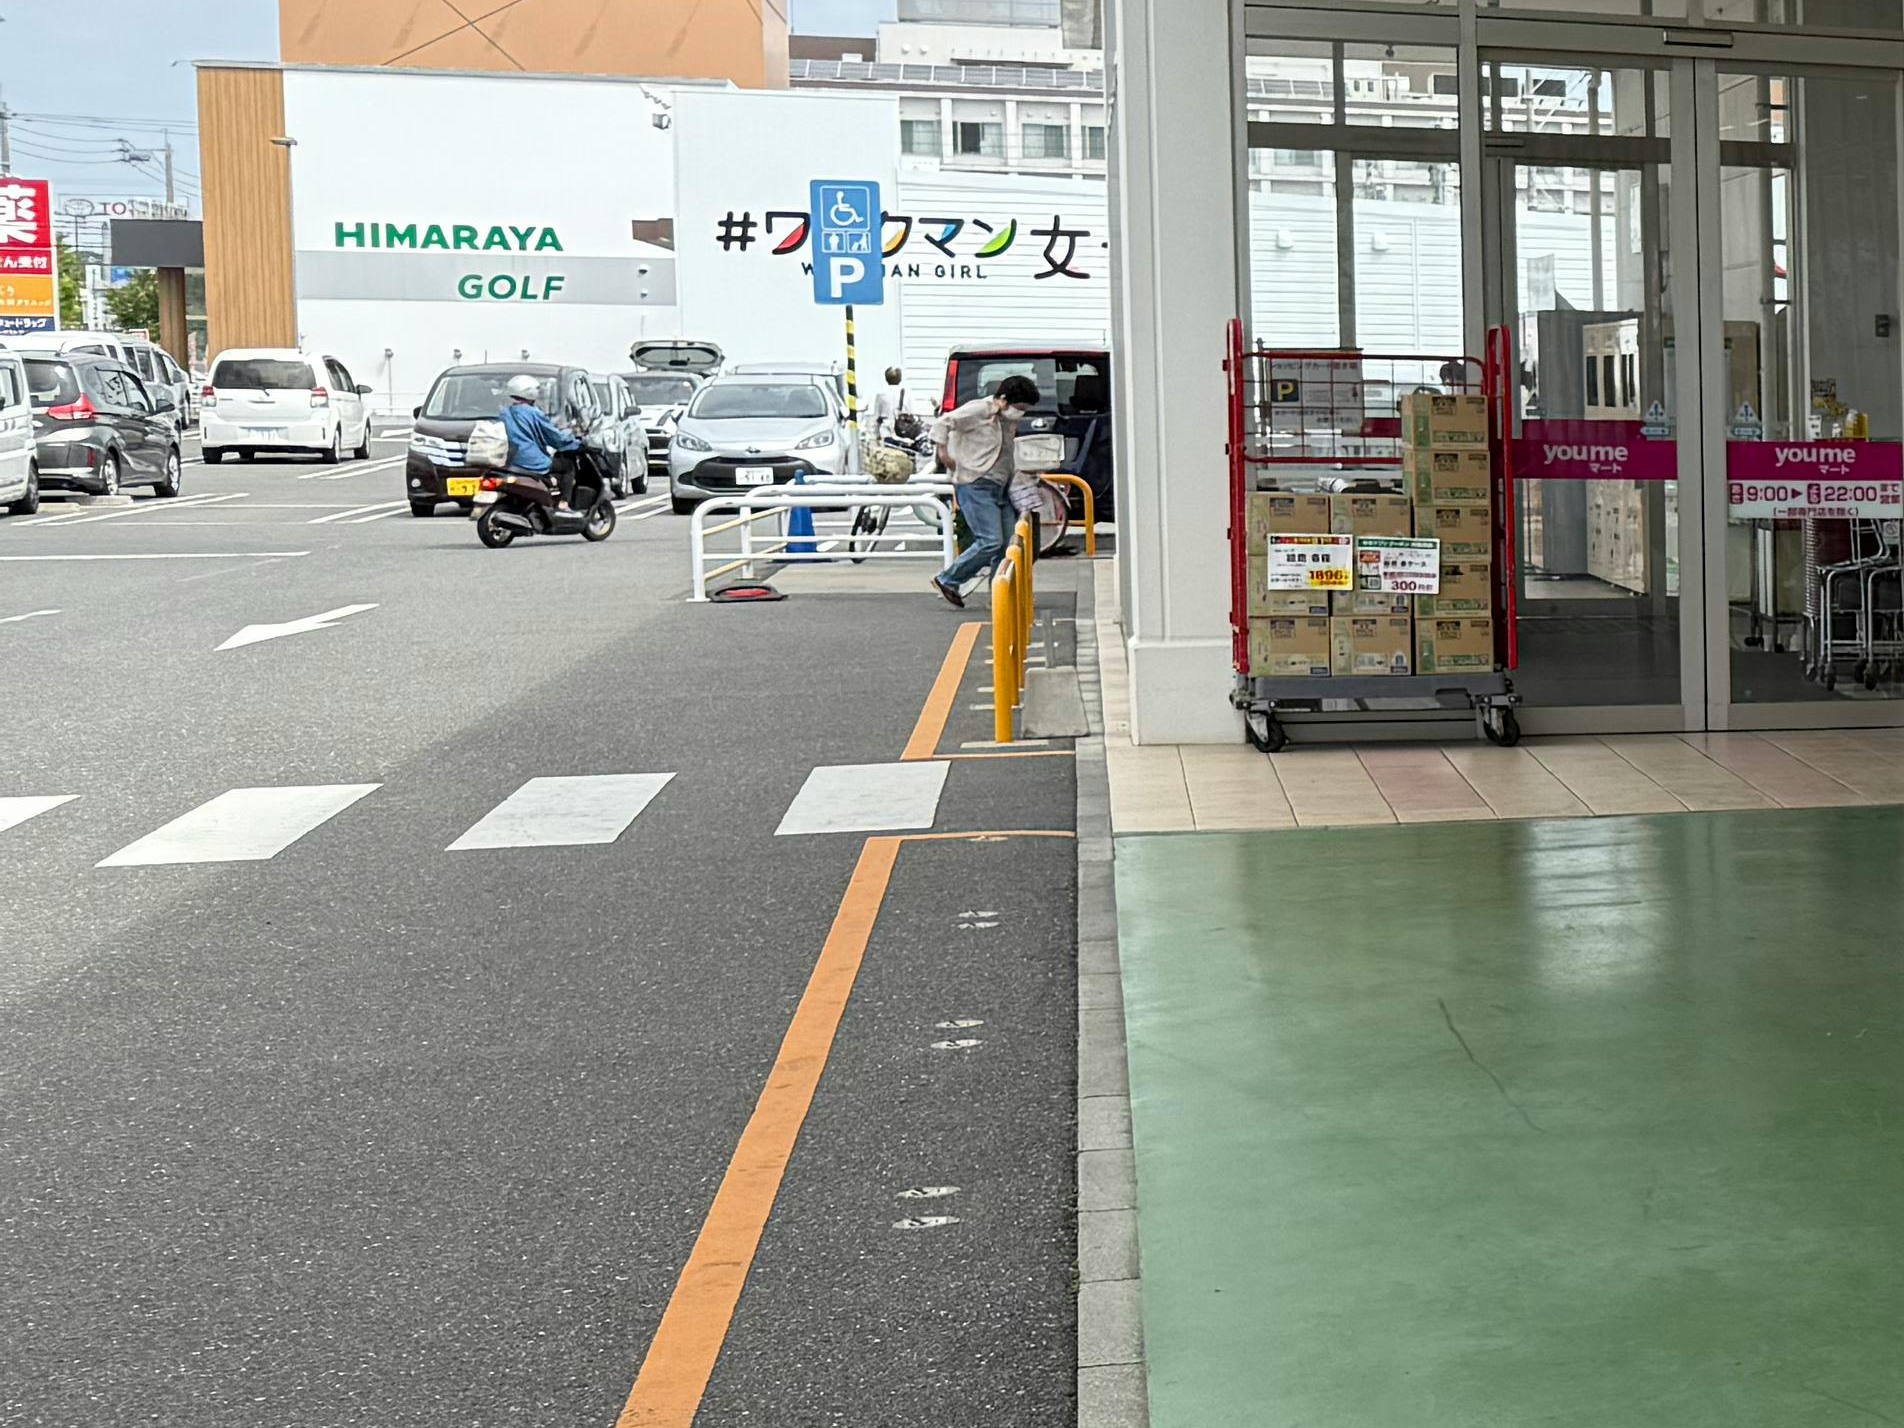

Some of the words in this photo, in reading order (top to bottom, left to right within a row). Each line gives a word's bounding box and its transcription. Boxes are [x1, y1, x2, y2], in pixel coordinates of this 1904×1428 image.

[334, 220, 564, 252] HIMARAYA
[716, 211, 1108, 279] #ワクマン女
[829, 257, 865, 298] P
[935, 264, 988, 279] GIRL
[457, 274, 565, 301] GOLF
[1277, 381, 1294, 401] P
[1543, 443, 1629, 465] youme
[1775, 447, 1856, 467] youme
[1589, 464, 1622, 474] マート
[1819, 465, 1850, 474] マート
[1747, 486, 1788, 501] 9:00
[1824, 486, 1877, 501] 22:00
